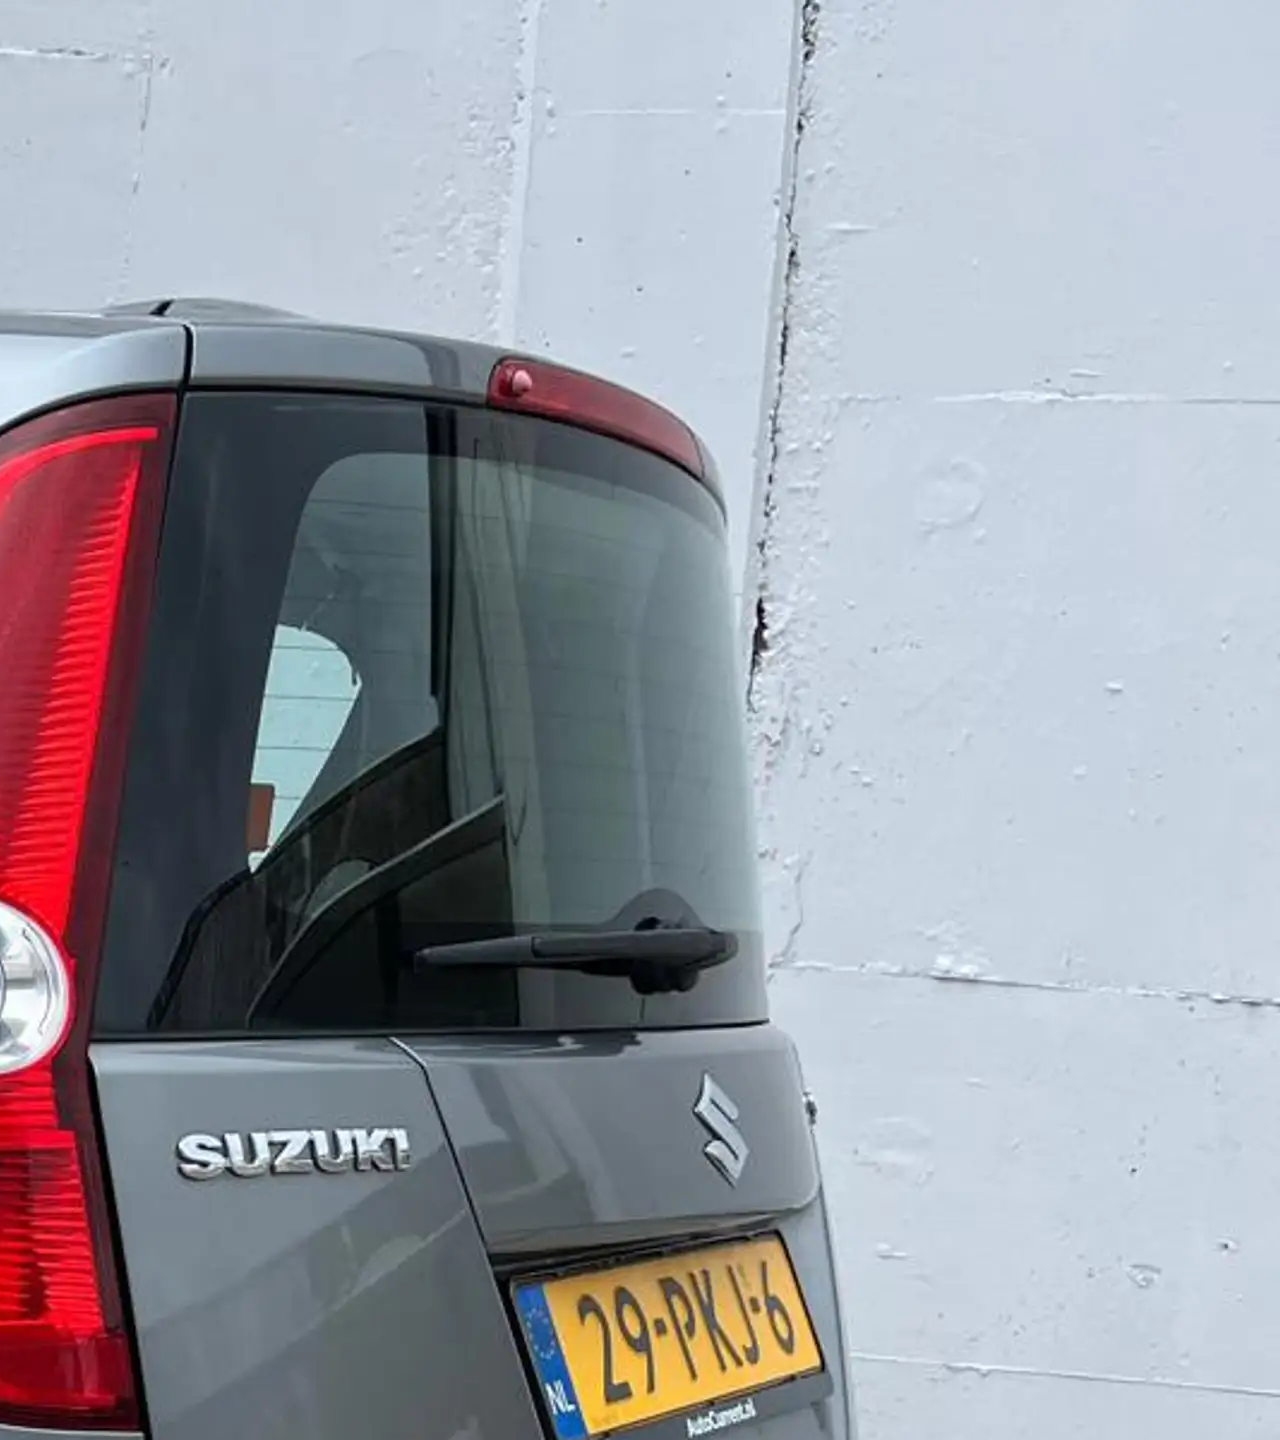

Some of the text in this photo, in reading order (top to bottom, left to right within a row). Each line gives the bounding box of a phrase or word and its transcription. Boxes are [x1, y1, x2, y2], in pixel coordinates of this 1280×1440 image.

[177, 1127, 412, 1180] SUZUKI
[576, 1260, 794, 1405] 29-PKJ-6
[545, 1382, 576, 1415] NL
